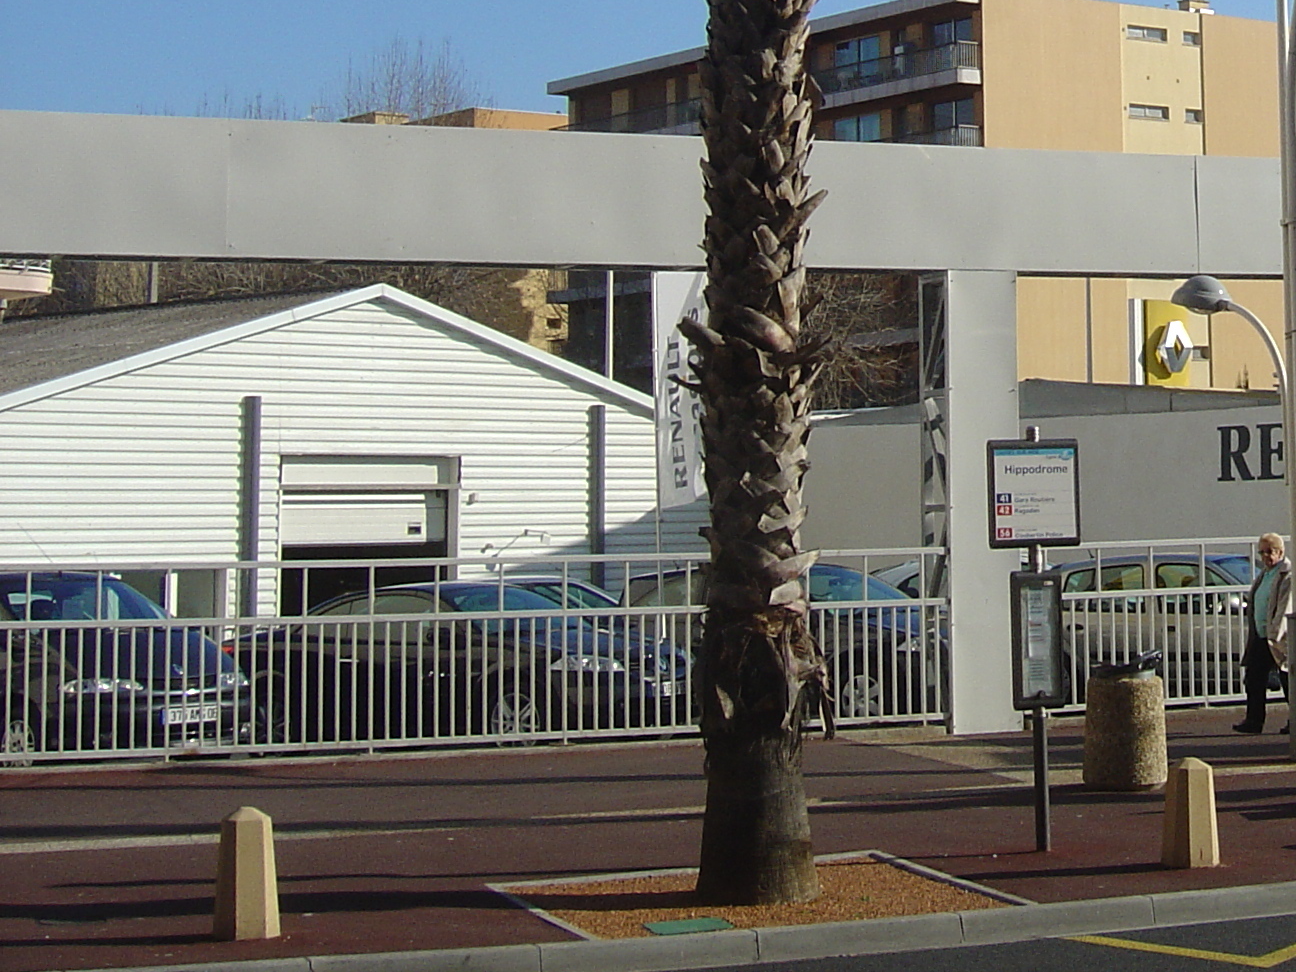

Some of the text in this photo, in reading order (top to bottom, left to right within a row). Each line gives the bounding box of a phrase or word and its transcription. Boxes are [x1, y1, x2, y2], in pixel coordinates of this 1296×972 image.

[666, 336, 688, 489] RENAULT
[1004, 465, 1068, 476] Hippodrome
[999, 494, 1009, 503] 41
[998, 506, 1010, 515] 42
[1000, 529, 1010, 537] 56
